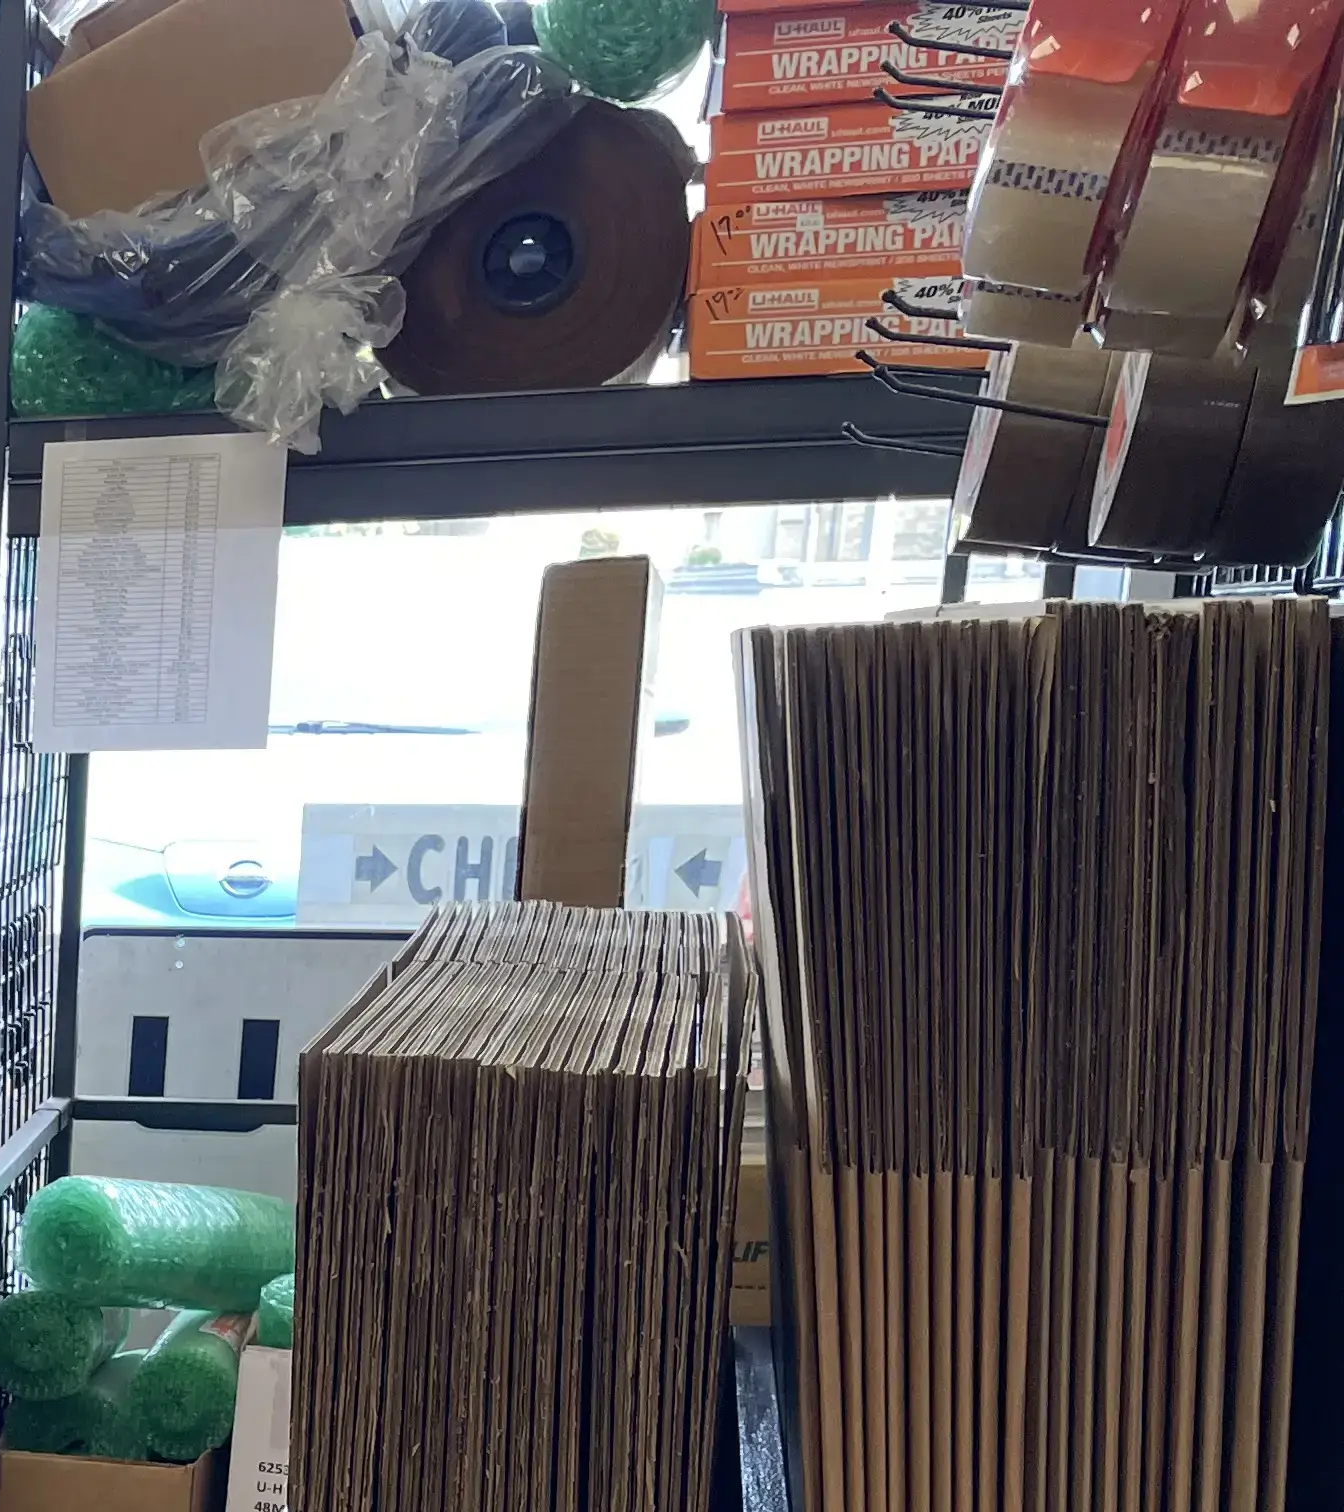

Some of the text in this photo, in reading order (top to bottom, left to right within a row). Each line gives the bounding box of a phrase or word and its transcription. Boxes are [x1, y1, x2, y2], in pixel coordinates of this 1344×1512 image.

[778, 21, 842, 36] U-HAUL
[772, 45, 926, 80] WRAPPING
[761, 122, 825, 136] U-HAUL
[755, 143, 909, 179] WRAPPING
[750, 224, 905, 259] WRAPPING
[753, 292, 815, 306] U-HAUL
